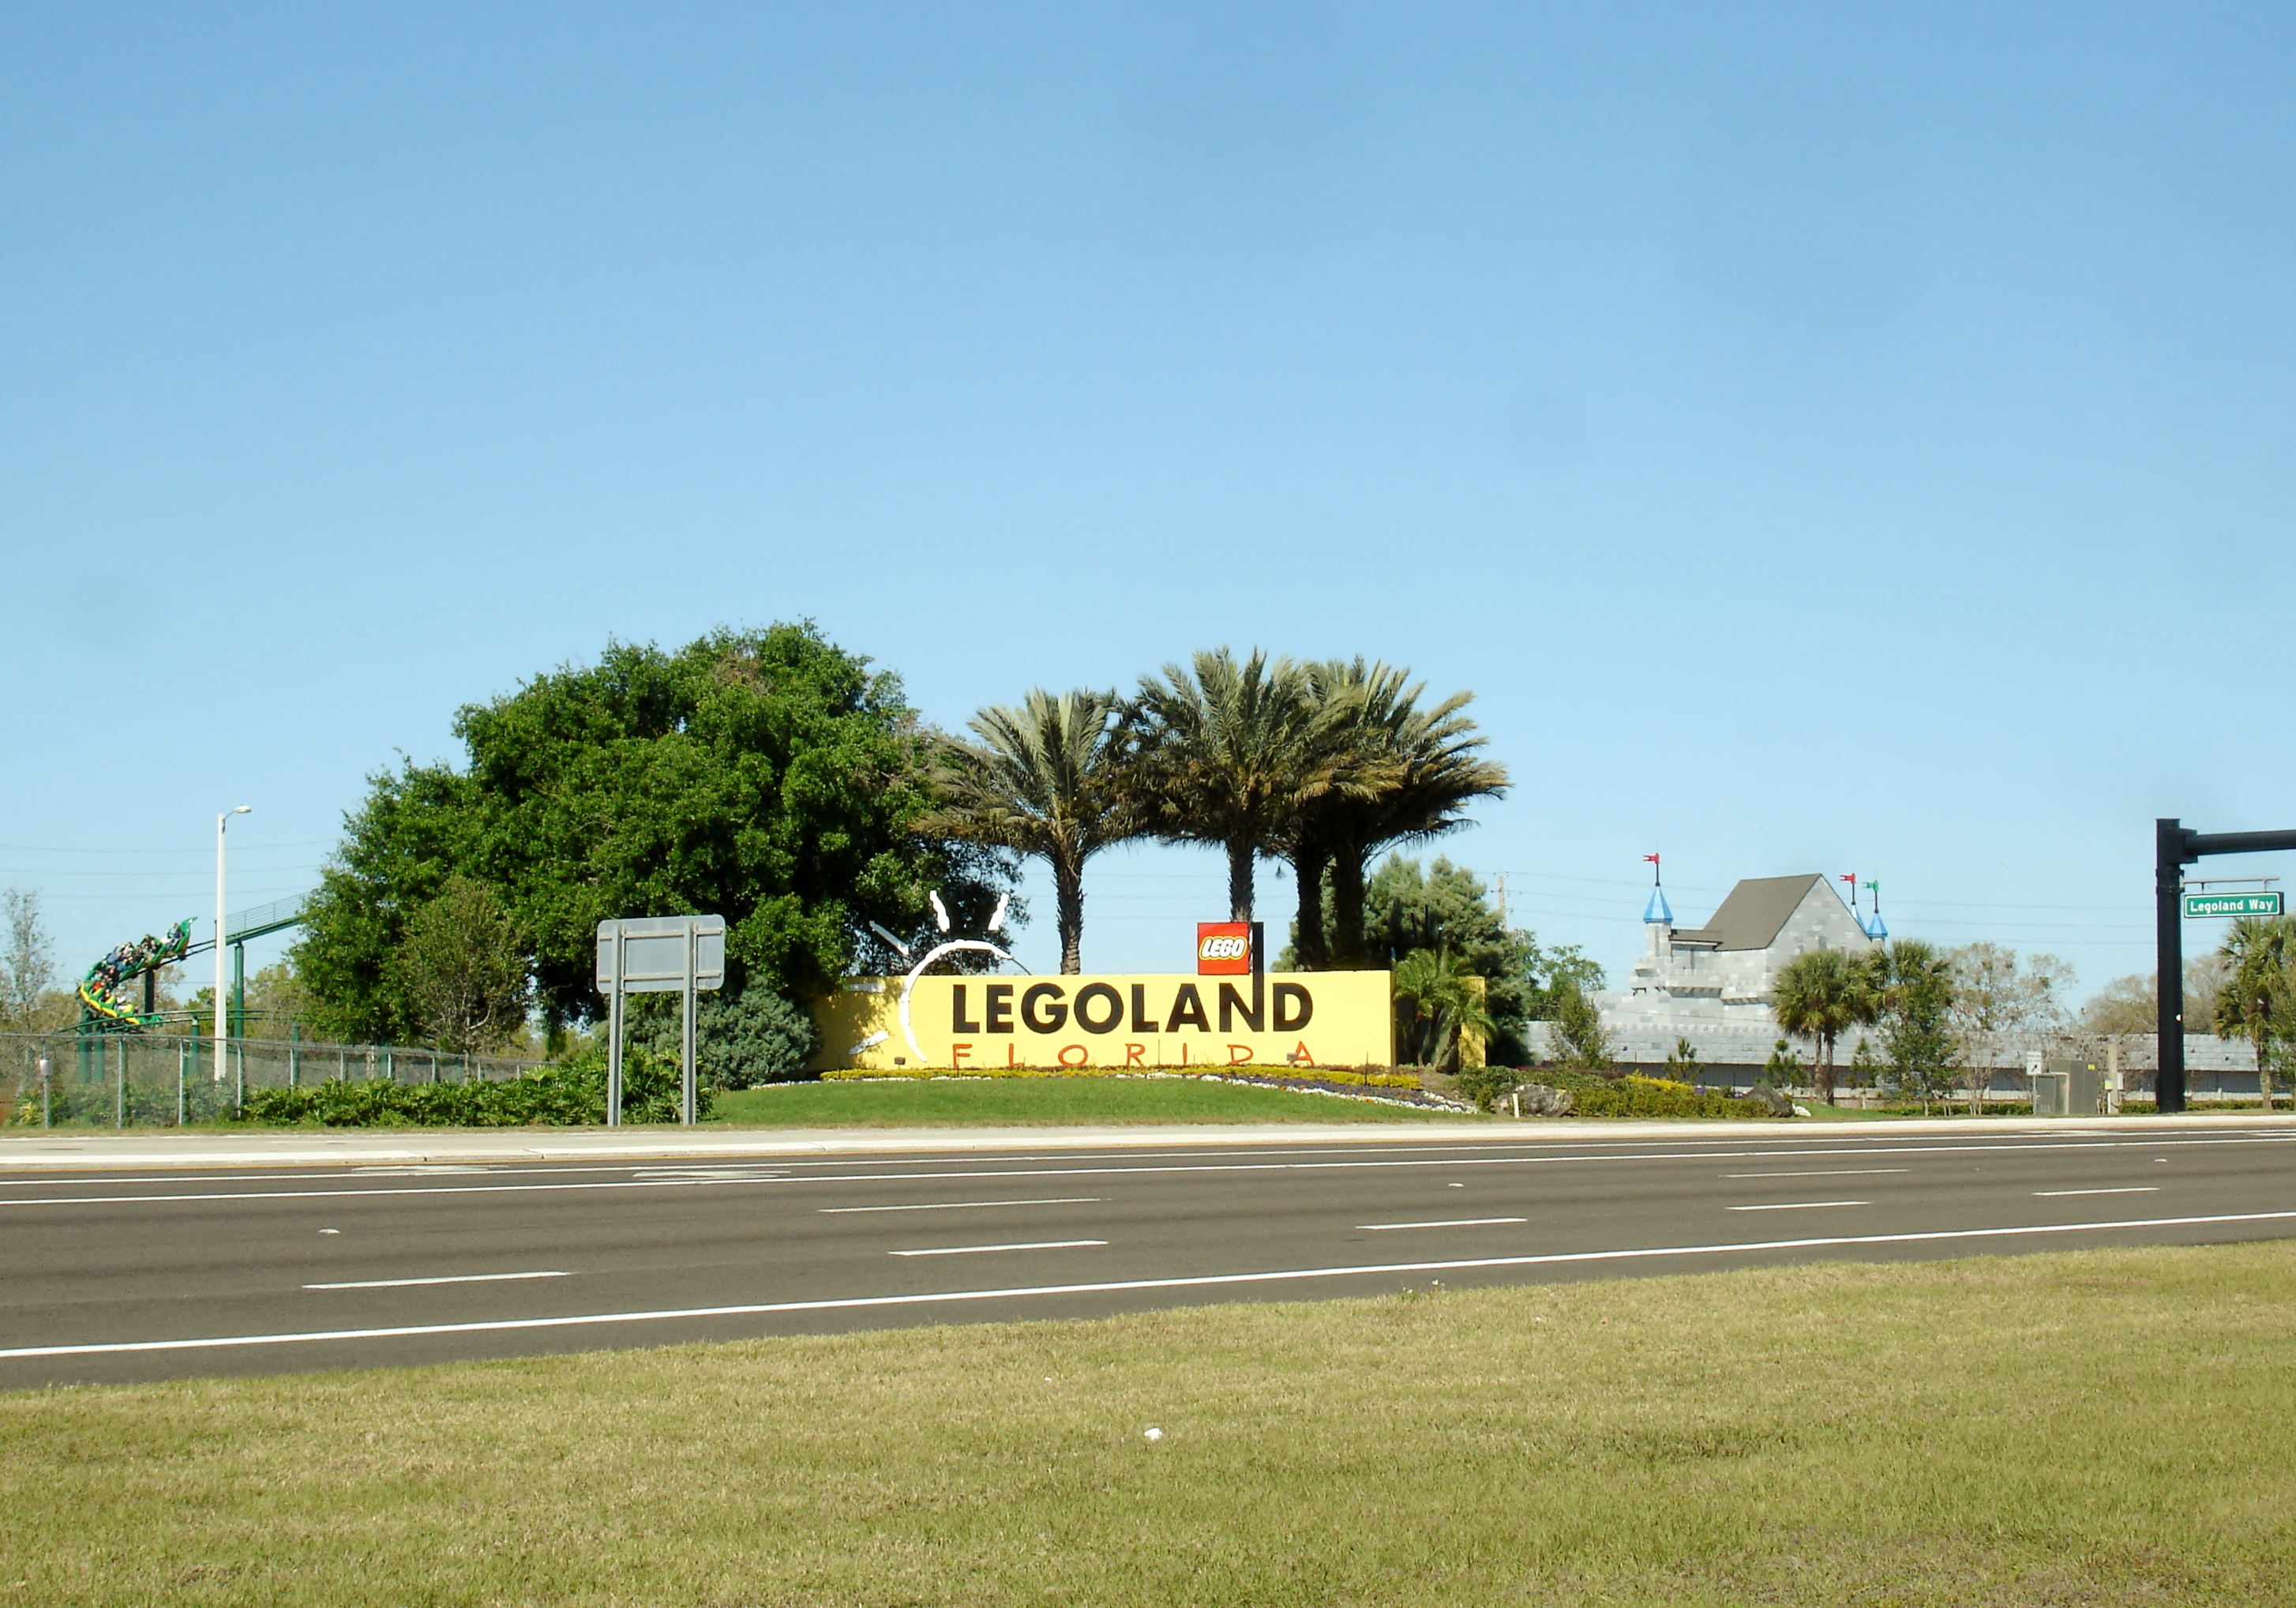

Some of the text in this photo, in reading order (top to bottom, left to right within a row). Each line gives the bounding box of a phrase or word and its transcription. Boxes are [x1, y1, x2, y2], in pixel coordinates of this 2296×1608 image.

[2189, 899, 2273, 914] Legoland Way
[1200, 937, 1246, 959] LEGO
[953, 982, 1313, 1034] LEGOLAND
[952, 1040, 1315, 1067] FLORIDA
